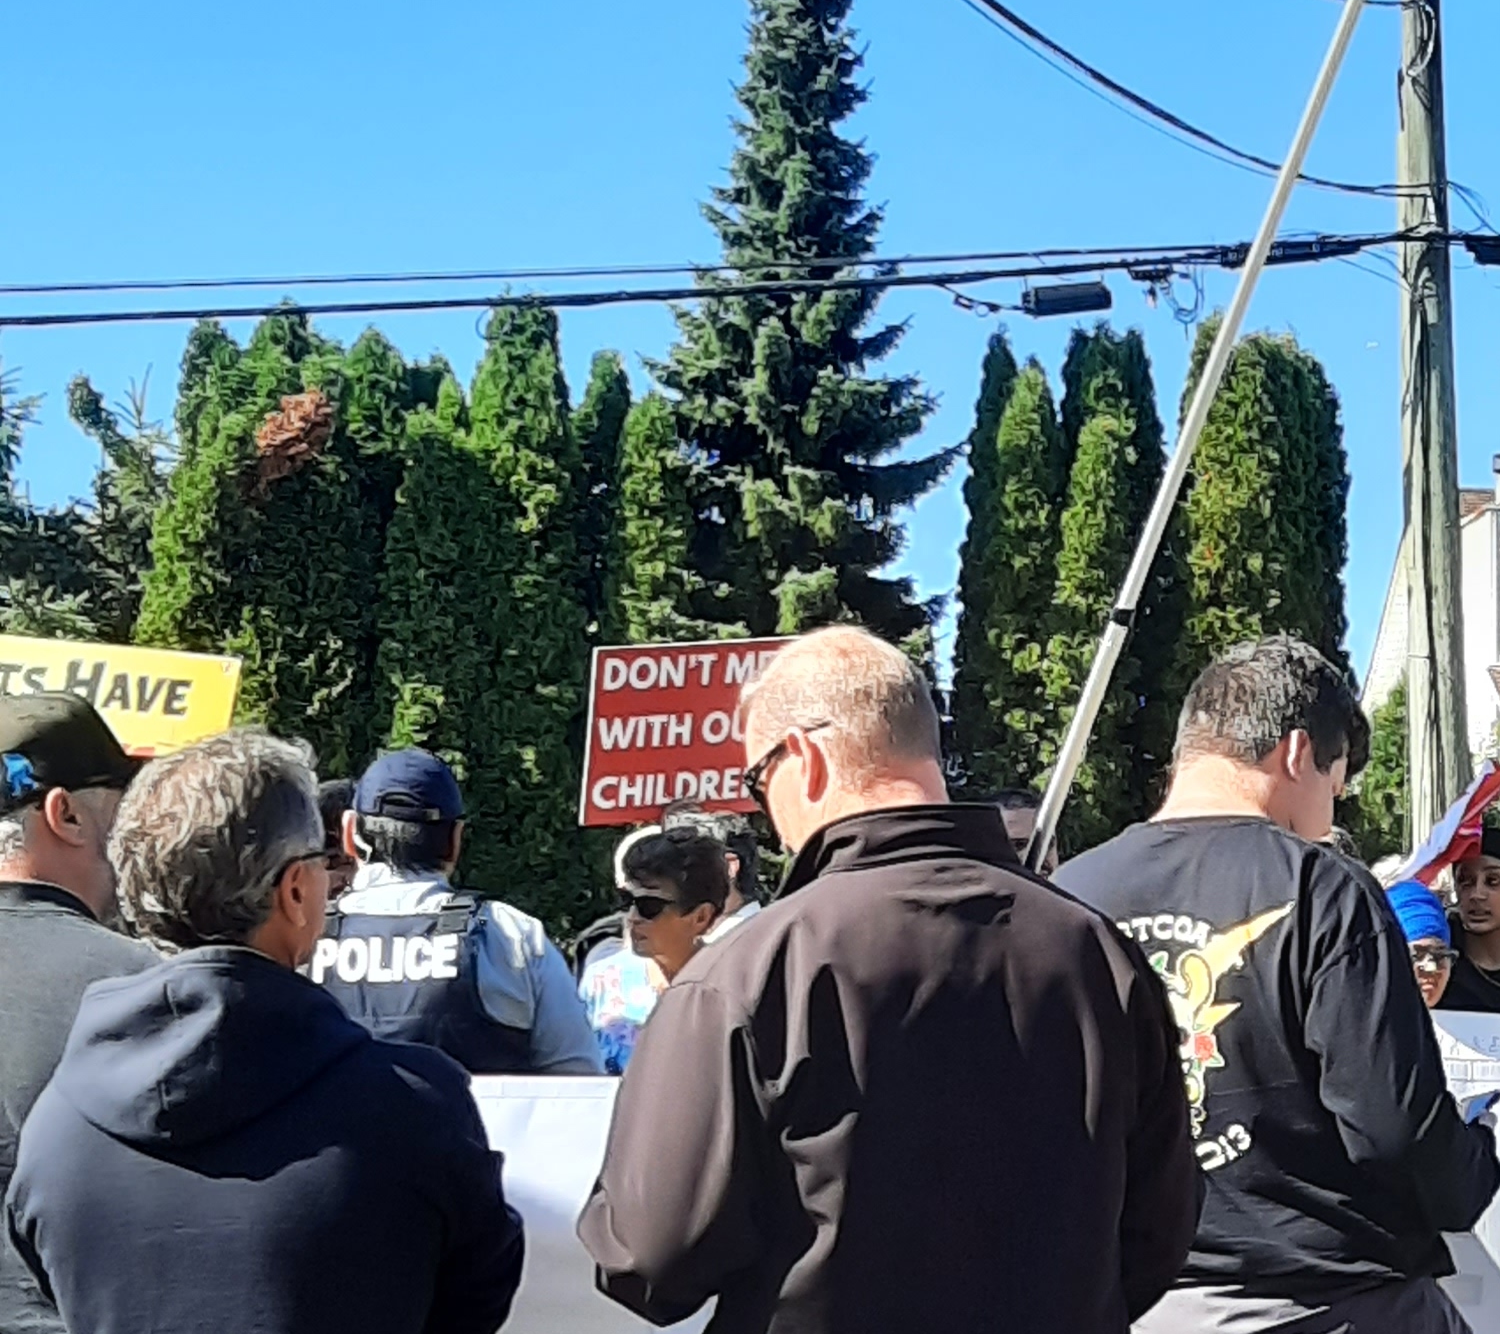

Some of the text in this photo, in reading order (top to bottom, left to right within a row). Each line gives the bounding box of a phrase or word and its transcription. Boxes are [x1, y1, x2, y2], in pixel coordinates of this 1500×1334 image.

[65, 658, 192, 716] HAVE
[603, 652, 718, 692] DON'T
[599, 712, 694, 751] WITH
[311, 933, 460, 984] POLICE
